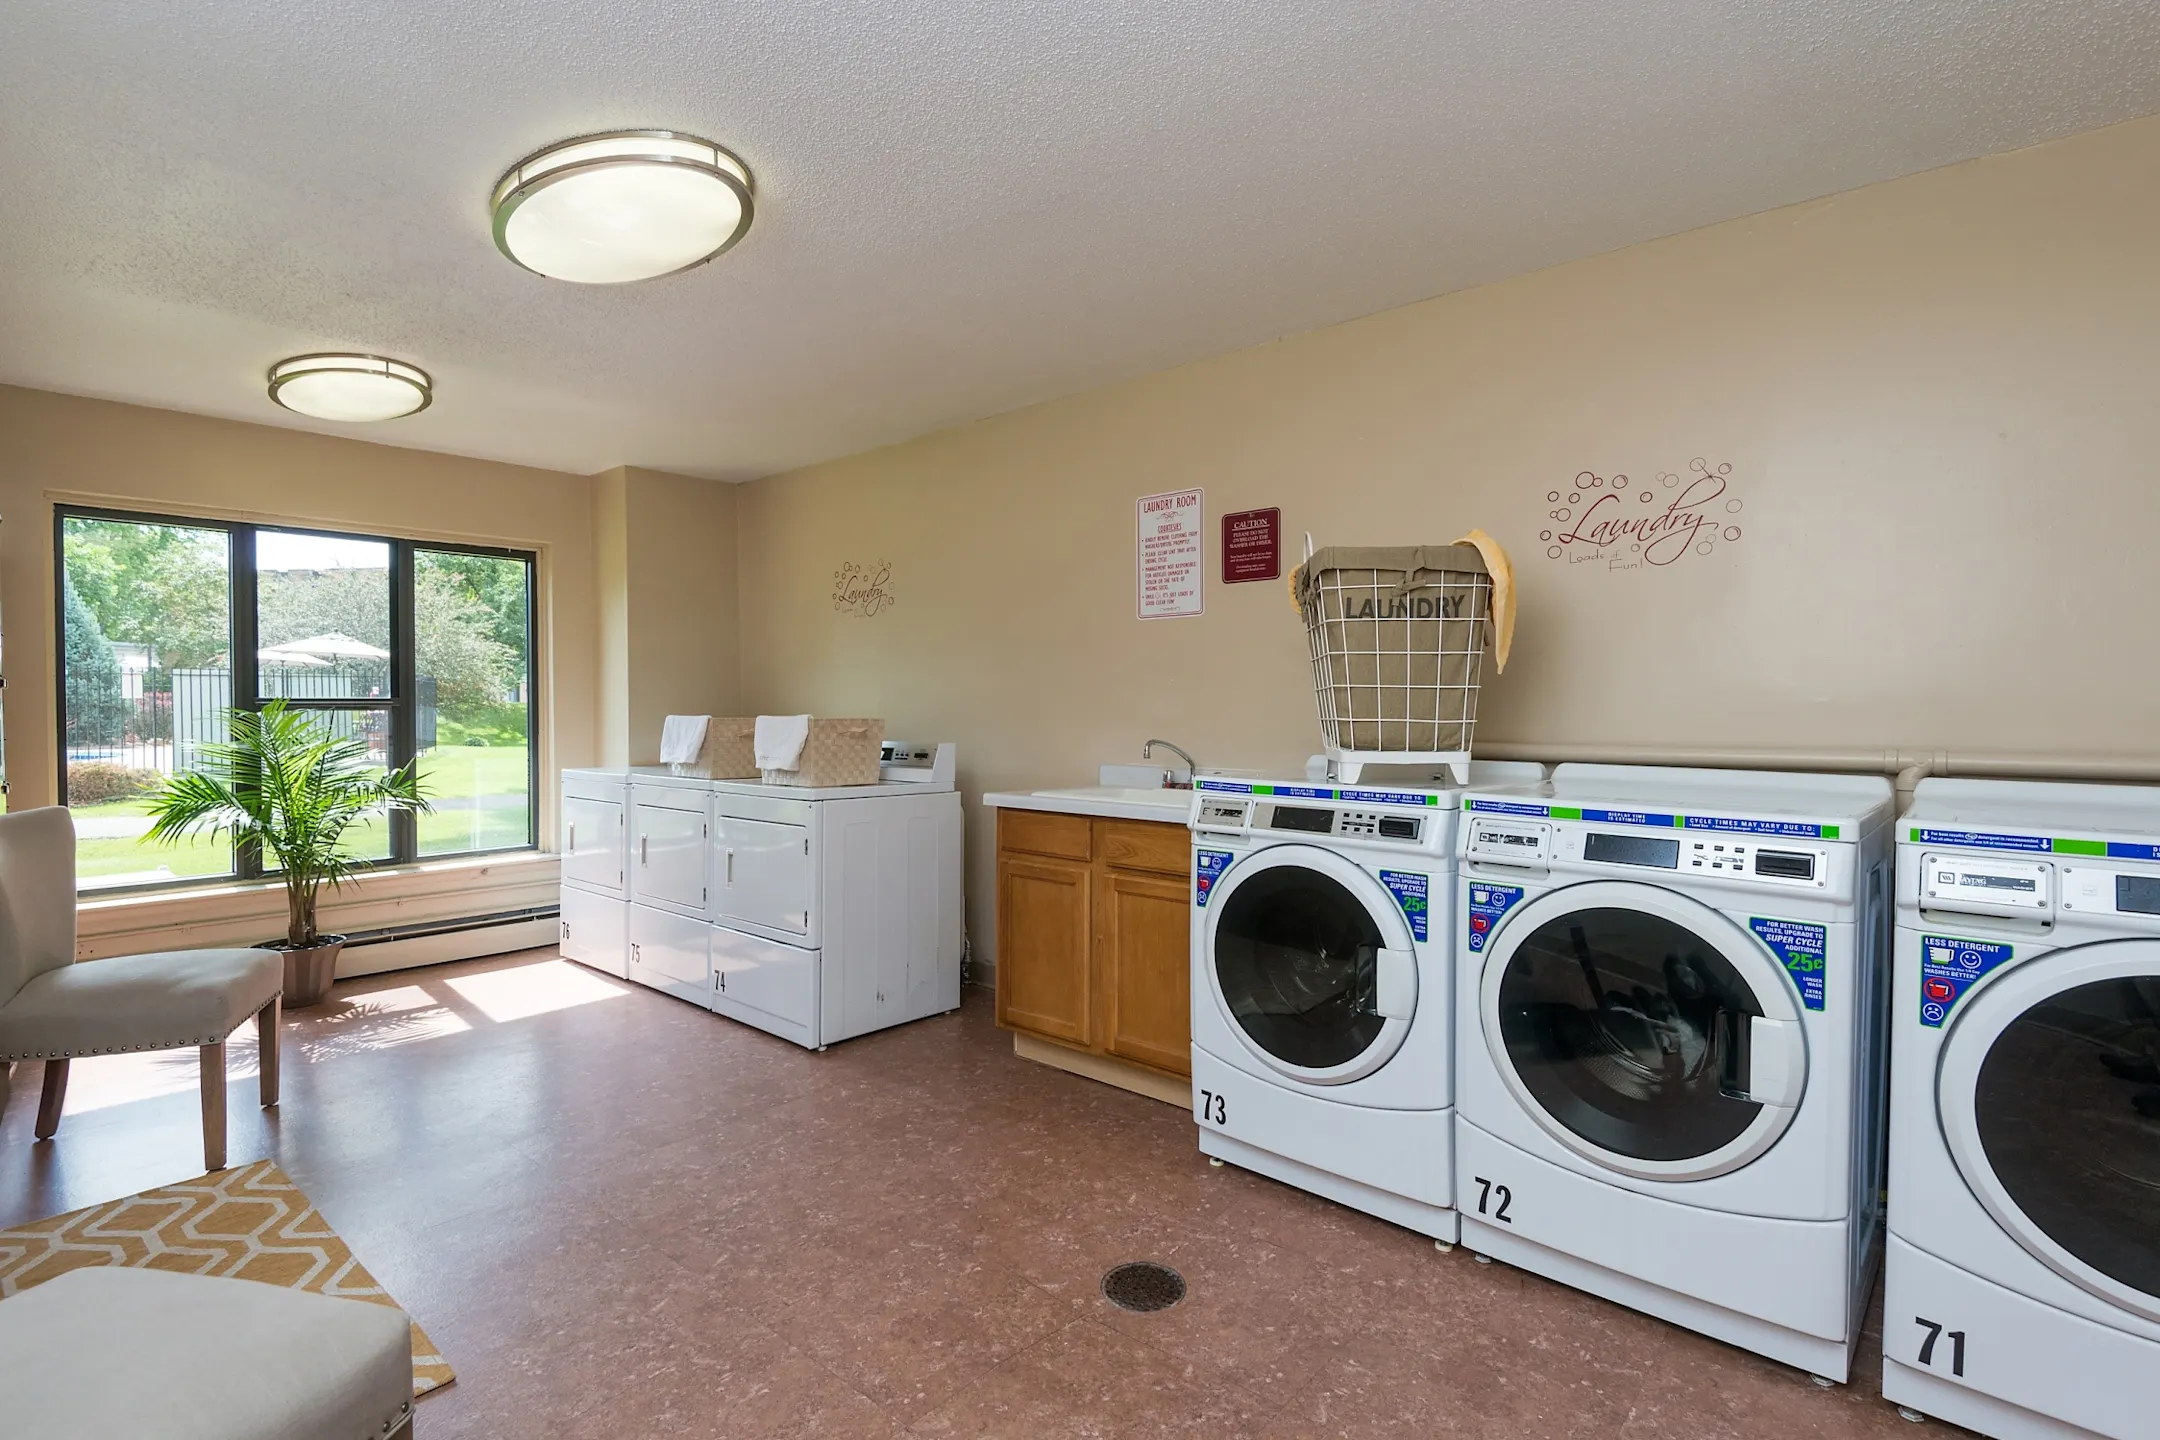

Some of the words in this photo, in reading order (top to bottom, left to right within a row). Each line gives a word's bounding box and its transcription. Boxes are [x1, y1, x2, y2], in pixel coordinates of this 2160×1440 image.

[1144, 498, 1173, 513] LAUNDRY
[1177, 494, 1196, 508] ROOM
[1234, 518, 1267, 529] CAUTION
[1558, 475, 1726, 565] Laundry
[1569, 549, 1604, 563] Loads
[1609, 558, 1643, 572] Fun!
[1345, 595, 1465, 619] LAUNDRY
[1485, 885, 1516, 894] DETERGENT
[562, 922, 570, 940] 76
[1784, 928, 1813, 937] UPGRADE
[1766, 934, 1794, 944] SUPER
[1795, 938, 1823, 948] CYCLE
[1785, 945, 1823, 955] ADDITIONAL
[1925, 937, 1946, 947] LESS
[1948, 940, 2000, 953] DETERGENT
[631, 943, 640, 963] 75
[1788, 952, 1823, 972] 25¢
[714, 970, 726, 992] 74
[1201, 1089, 1226, 1125] 73
[1475, 1176, 1511, 1224] 72
[1916, 1316, 1965, 1378] 71
